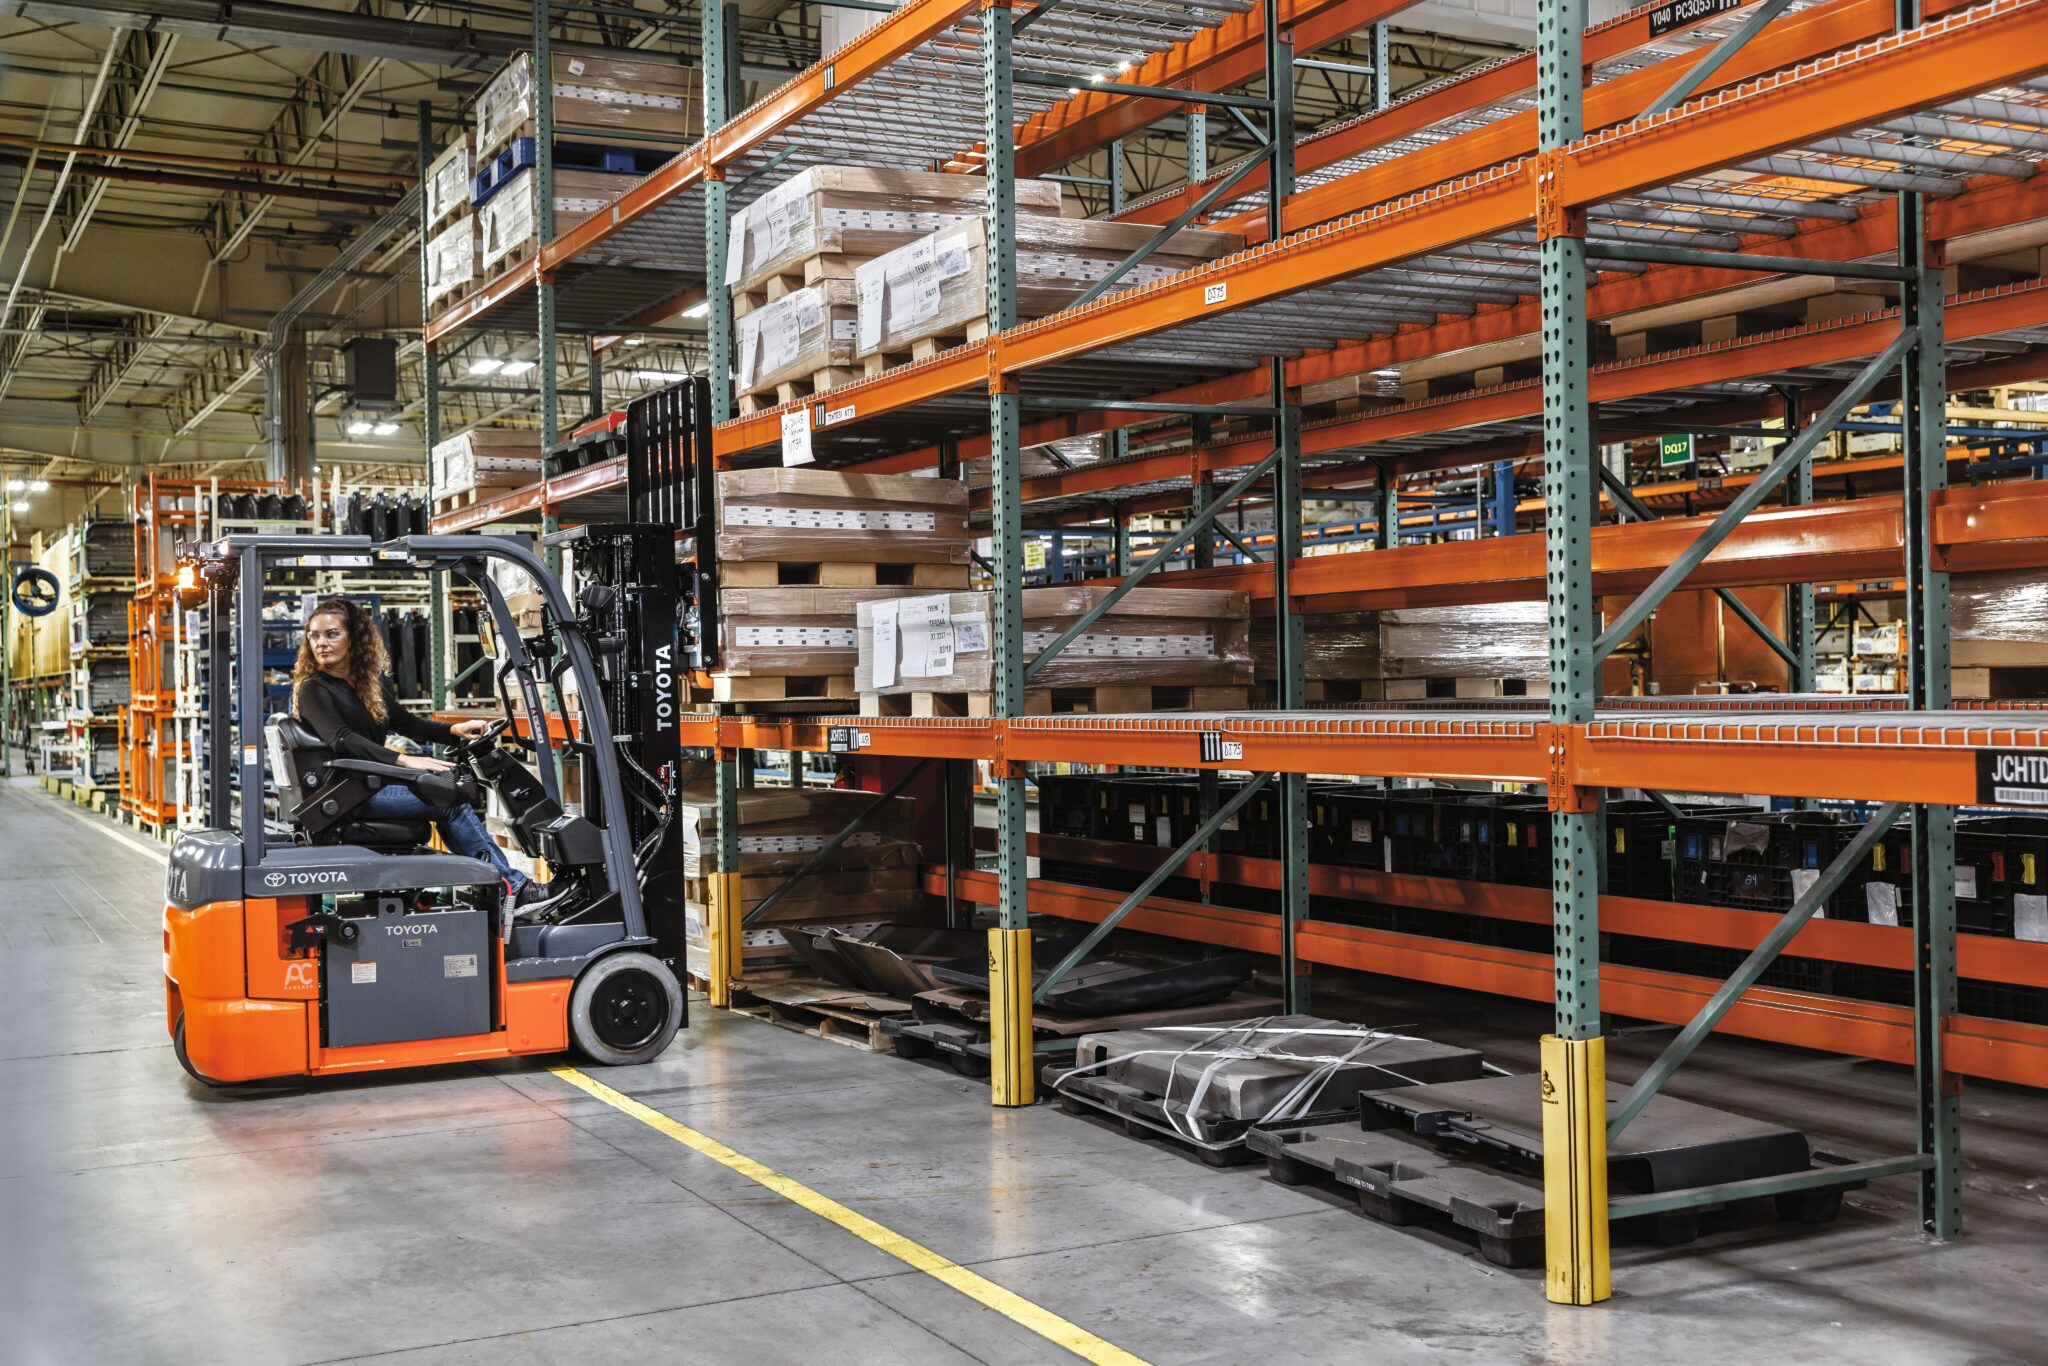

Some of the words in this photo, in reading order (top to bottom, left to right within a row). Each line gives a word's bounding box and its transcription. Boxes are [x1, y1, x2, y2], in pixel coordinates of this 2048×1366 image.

[1652, 7, 1671, 27] Y040
[1664, 441, 1688, 455] DQ17
[655, 644, 673, 732] TOYOTA
[1991, 755, 2048, 784] JCHTD
[289, 871, 348, 885] TOYOTA
[385, 924, 438, 936] TOYOTA
[284, 962, 313, 986] AC
